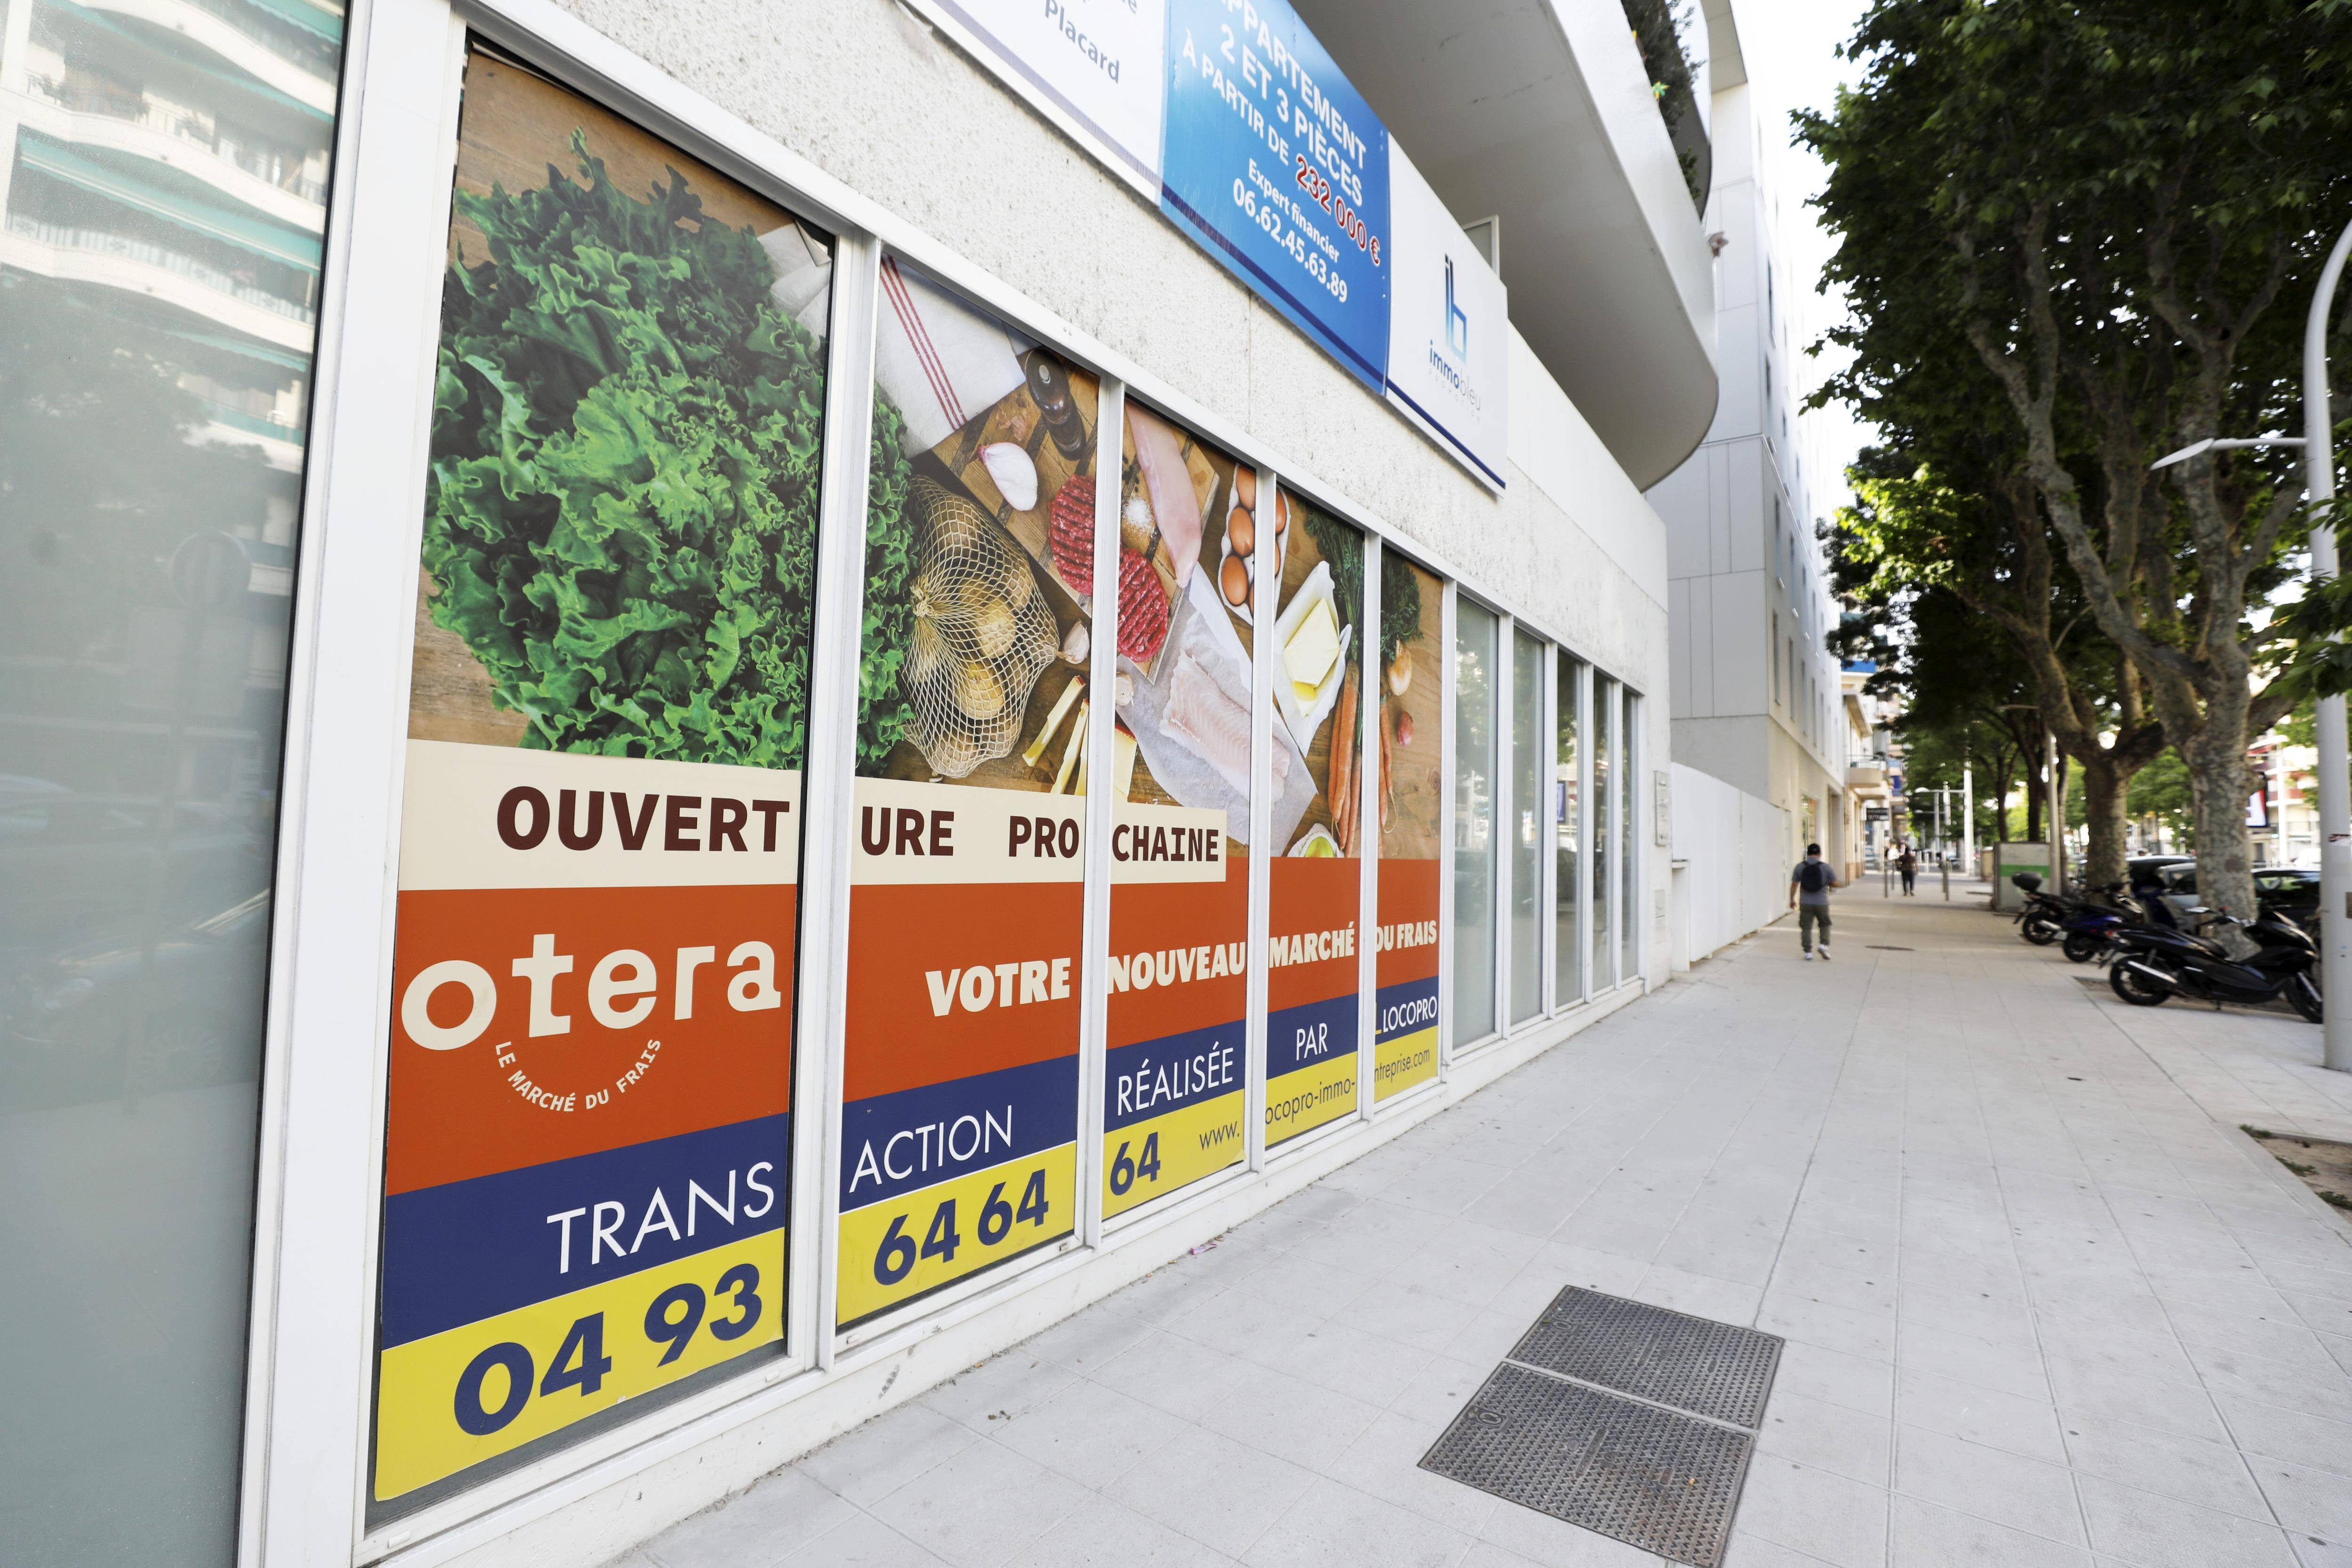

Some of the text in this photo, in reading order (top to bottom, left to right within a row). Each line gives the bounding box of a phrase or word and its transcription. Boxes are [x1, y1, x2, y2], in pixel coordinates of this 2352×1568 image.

[1045, 0, 1120, 84] Placard
[1221, 0, 1366, 168] PARTEMENT
[1183, 27, 1381, 267] À PARTIR DE 232 000 €
[1221, 23, 1362, 207] 2 ET 3 PIÈCES
[1233, 178, 1348, 302] 06.62.45.63.89
[1249, 158, 1340, 263] Expert financier
[1430, 339, 1481, 411] immobleu
[497, 785, 1219, 862] OUVERT URE PRO CHAINE
[401, 933, 781, 1051] otera
[925, 920, 1437, 1017] VOTRE NOUVEAU MARCHÉ DU FRAIS
[495, 1039, 661, 1112] LE MARCHÉ DU FRAIS
[546, 1161, 775, 1274] TRANS
[848, 1105, 1012, 1193] ACTION
[1118, 1041, 1234, 1116] RÉALISÉE
[1296, 1022, 1328, 1061] PAR
[1199, 1120, 1240, 1151] www.
[454, 1132, 1161, 1436] 04 93 64 64 64
